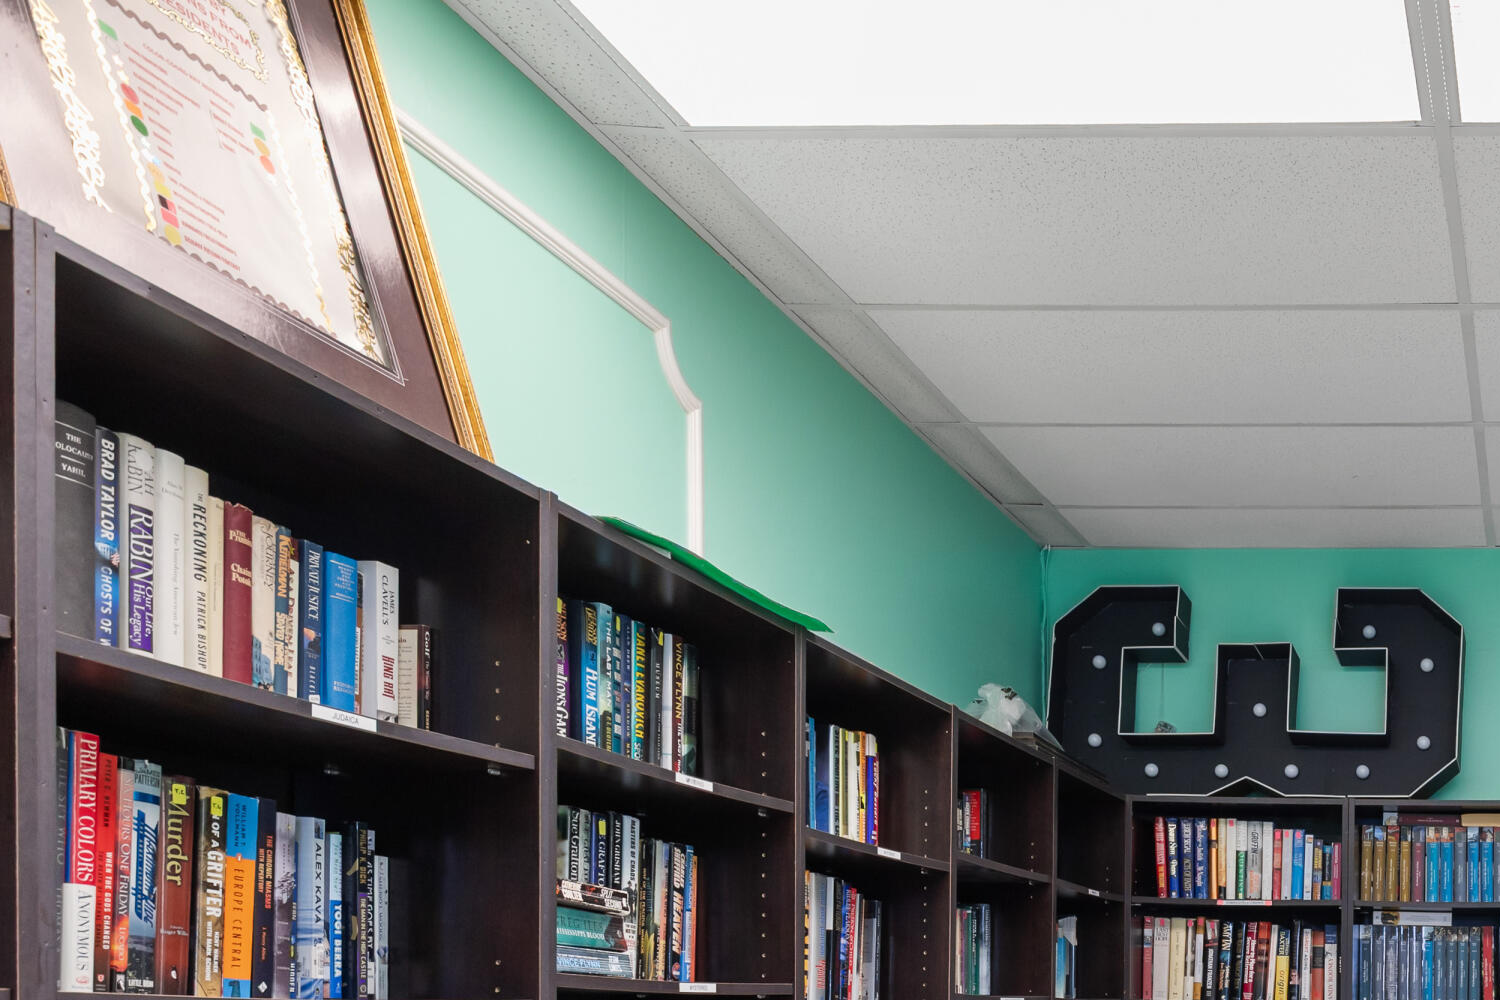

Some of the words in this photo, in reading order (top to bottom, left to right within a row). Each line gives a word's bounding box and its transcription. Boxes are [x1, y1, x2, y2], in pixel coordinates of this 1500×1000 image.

[100, 438, 115, 481] BRAD
[100, 483, 115, 542] TAYLOR
[130, 506, 154, 582] RABIN
[193, 503, 207, 583] RECKONING
[308, 549, 321, 586] PRIVATE
[100, 566, 112, 614] GHOSTS
[308, 587, 319, 622] JUSTICE
[381, 574, 389, 626] CLAVELL'S
[100, 618, 112, 635] OF
[129, 602, 142, 646] Legacy
[197, 591, 207, 629] PATRICK
[197, 631, 207, 670] BISHOP
[381, 654, 396, 679] KING
[381, 680, 396, 701] RAT
[585, 667, 598, 700] PLUM
[674, 681, 682, 720] FLYNN
[331, 713, 360, 727] JUDAICA
[635, 671, 646, 739] EVANOVICH
[77, 737, 98, 811] PRIMARY
[120, 797, 133, 841] HOURS
[166, 789, 189, 886] Murder
[211, 821, 220, 839] OF
[570, 810, 581, 835] Sue
[76, 815, 97, 883] COLORS
[105, 851, 113, 874] WHEN
[119, 843, 131, 872] ONE
[265, 849, 273, 879] CHRONIC
[314, 842, 323, 882] ALEX
[569, 835, 581, 882] Grafton
[613, 844, 621, 885] GRISHAM
[630, 850, 636, 859] OF
[103, 892, 111, 913] GODS
[104, 875, 112, 891] THE
[118, 874, 130, 919] FRIDAY
[205, 849, 224, 919] GRIFTER
[232, 867, 245, 912] EUROPE
[314, 885, 323, 924] KAVA
[333, 903, 343, 935] YOGI
[672, 891, 682, 955] HEAVEN
[76, 889, 93, 971] ANONYMOUS
[102, 914, 111, 950] CHANGED
[230, 919, 244, 969] CENTRAL
[333, 939, 342, 978] BERRA
